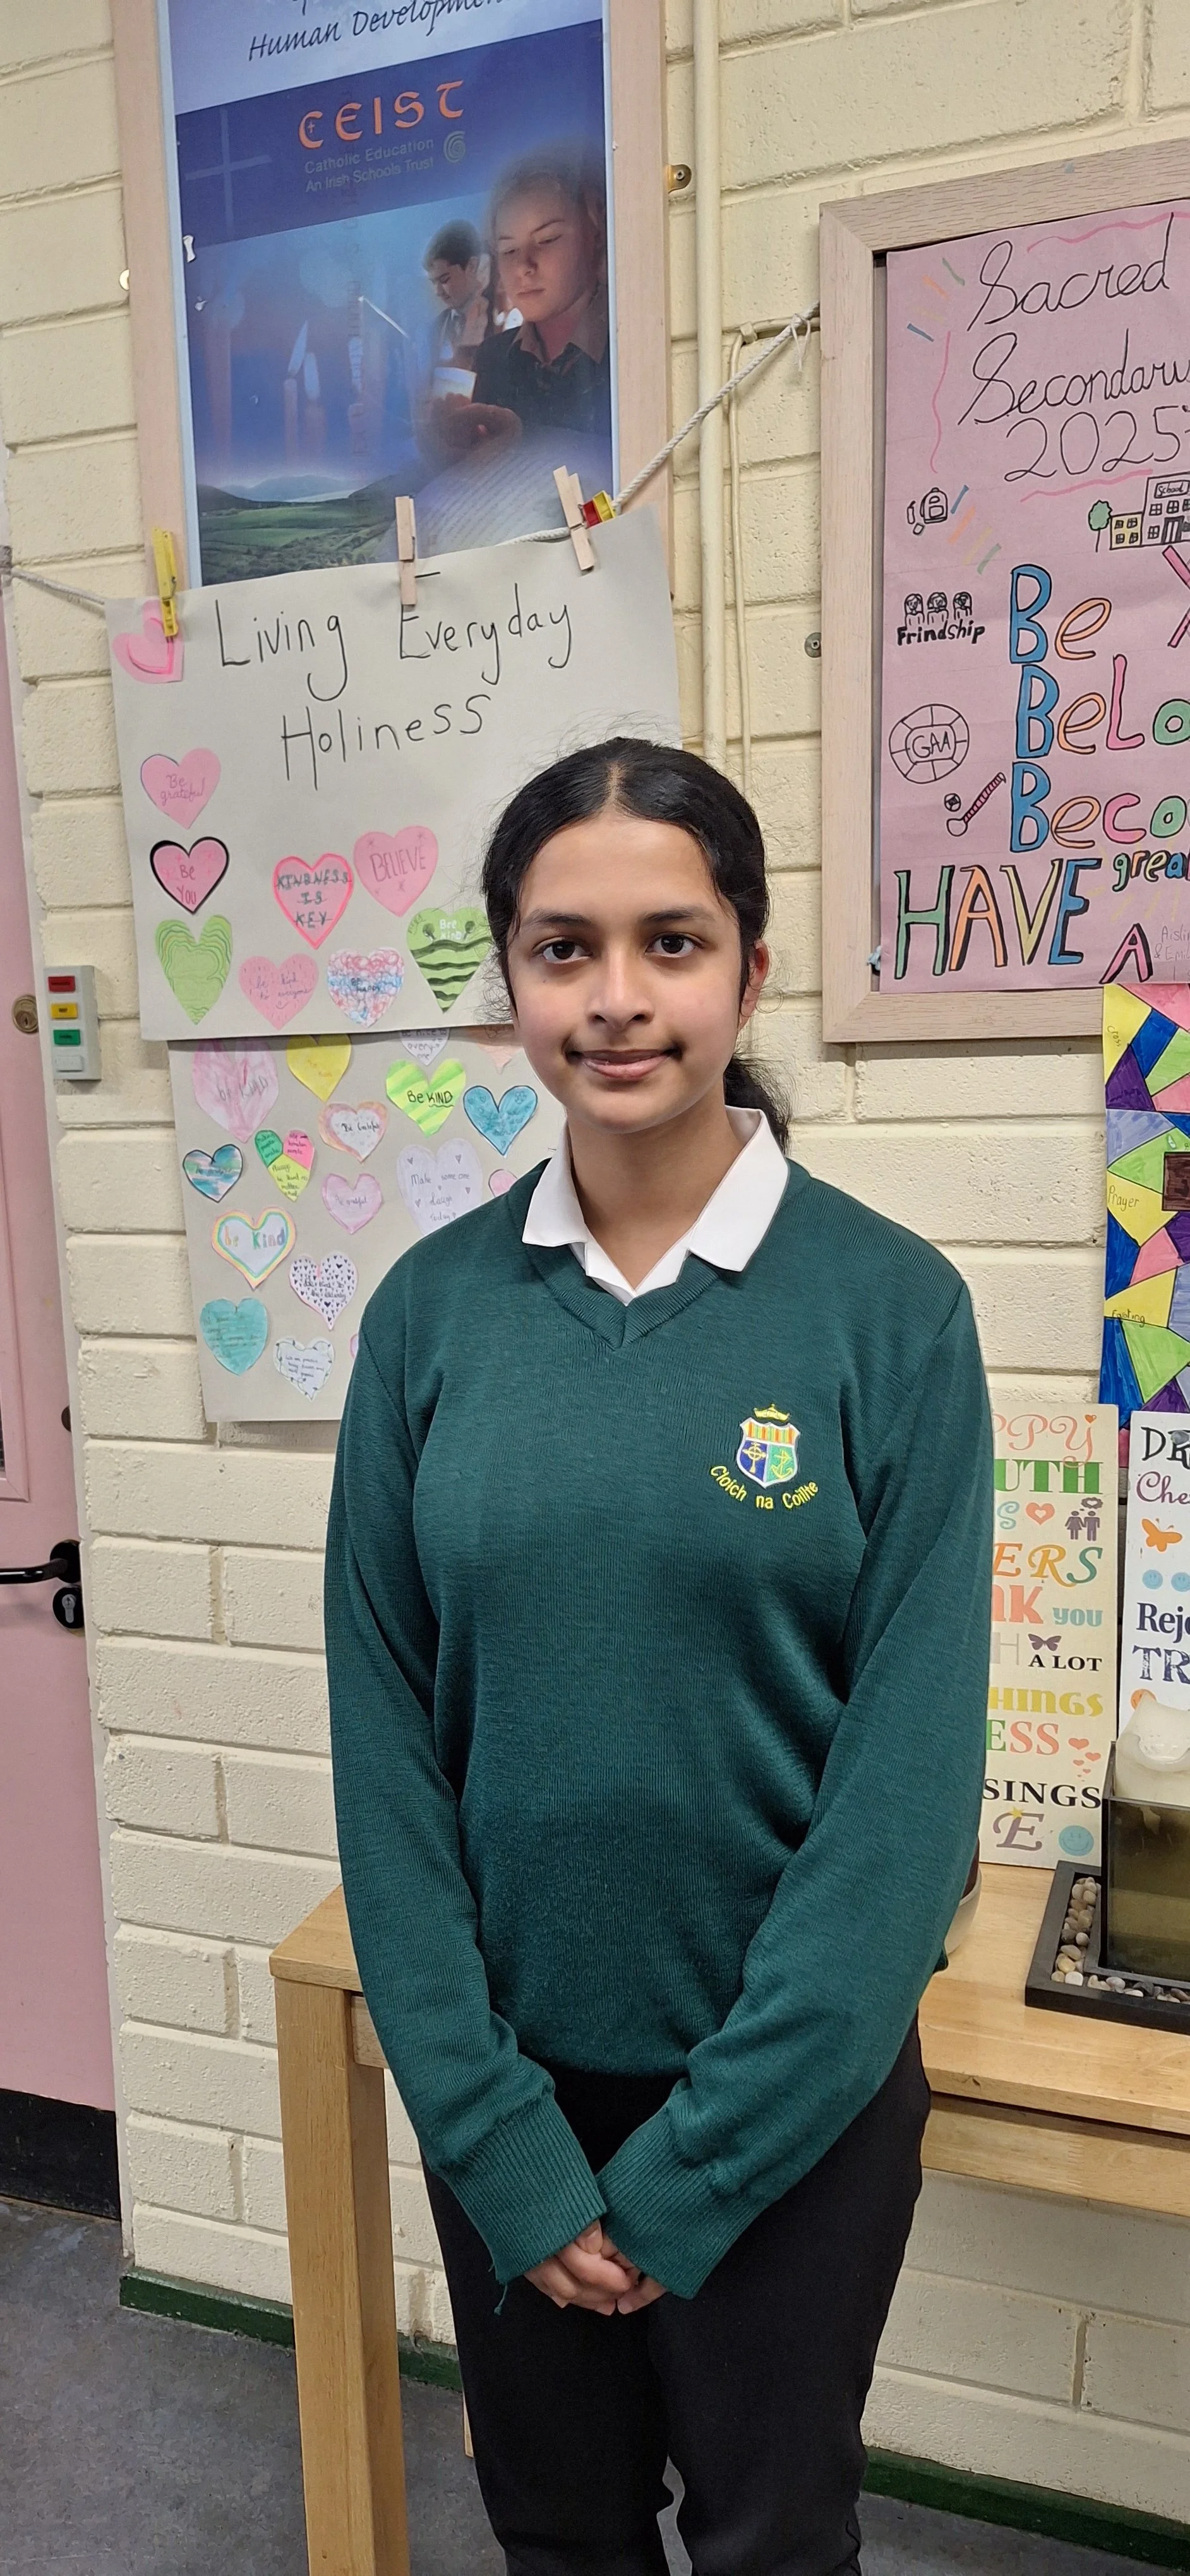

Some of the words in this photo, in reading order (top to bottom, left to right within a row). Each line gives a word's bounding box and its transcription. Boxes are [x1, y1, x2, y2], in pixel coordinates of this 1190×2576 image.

[249, 21, 342, 61] Human
[352, 0, 501, 37] Developm
[299, 80, 464, 150] CEIST
[305, 153, 361, 175] Catholic
[364, 138, 435, 163] Education
[305, 179, 322, 193] An
[325, 174, 349, 189] Irish
[353, 162, 402, 183] Schools
[405, 157, 435, 174] Trust
[966, 212, 1170, 331] Sacred
[1010, 563, 1112, 664] Be
[215, 599, 348, 702] Living
[281, 693, 491, 791] Holiness
[912, 730, 951, 758] GAA
[166, 773, 187, 789] Be
[277, 869, 349, 890] KINDNESS
[369, 846, 427, 883] BELIEVE
[300, 891, 323, 905] IS
[295, 911, 327, 929] KEY
[894, 857, 1103, 980] HAVE
[1099, 922, 1153, 984] A
[1107, 1184, 1140, 1212] Prayer
[711, 1465, 748, 1502] Cloich
[756, 1494, 774, 1509] na
[782, 1481, 819, 1509] Coillte
[1028, 1654, 1046, 1669] A
[1052, 1654, 1103, 1672] LOT
[983, 1777, 1102, 1810] SINGS
